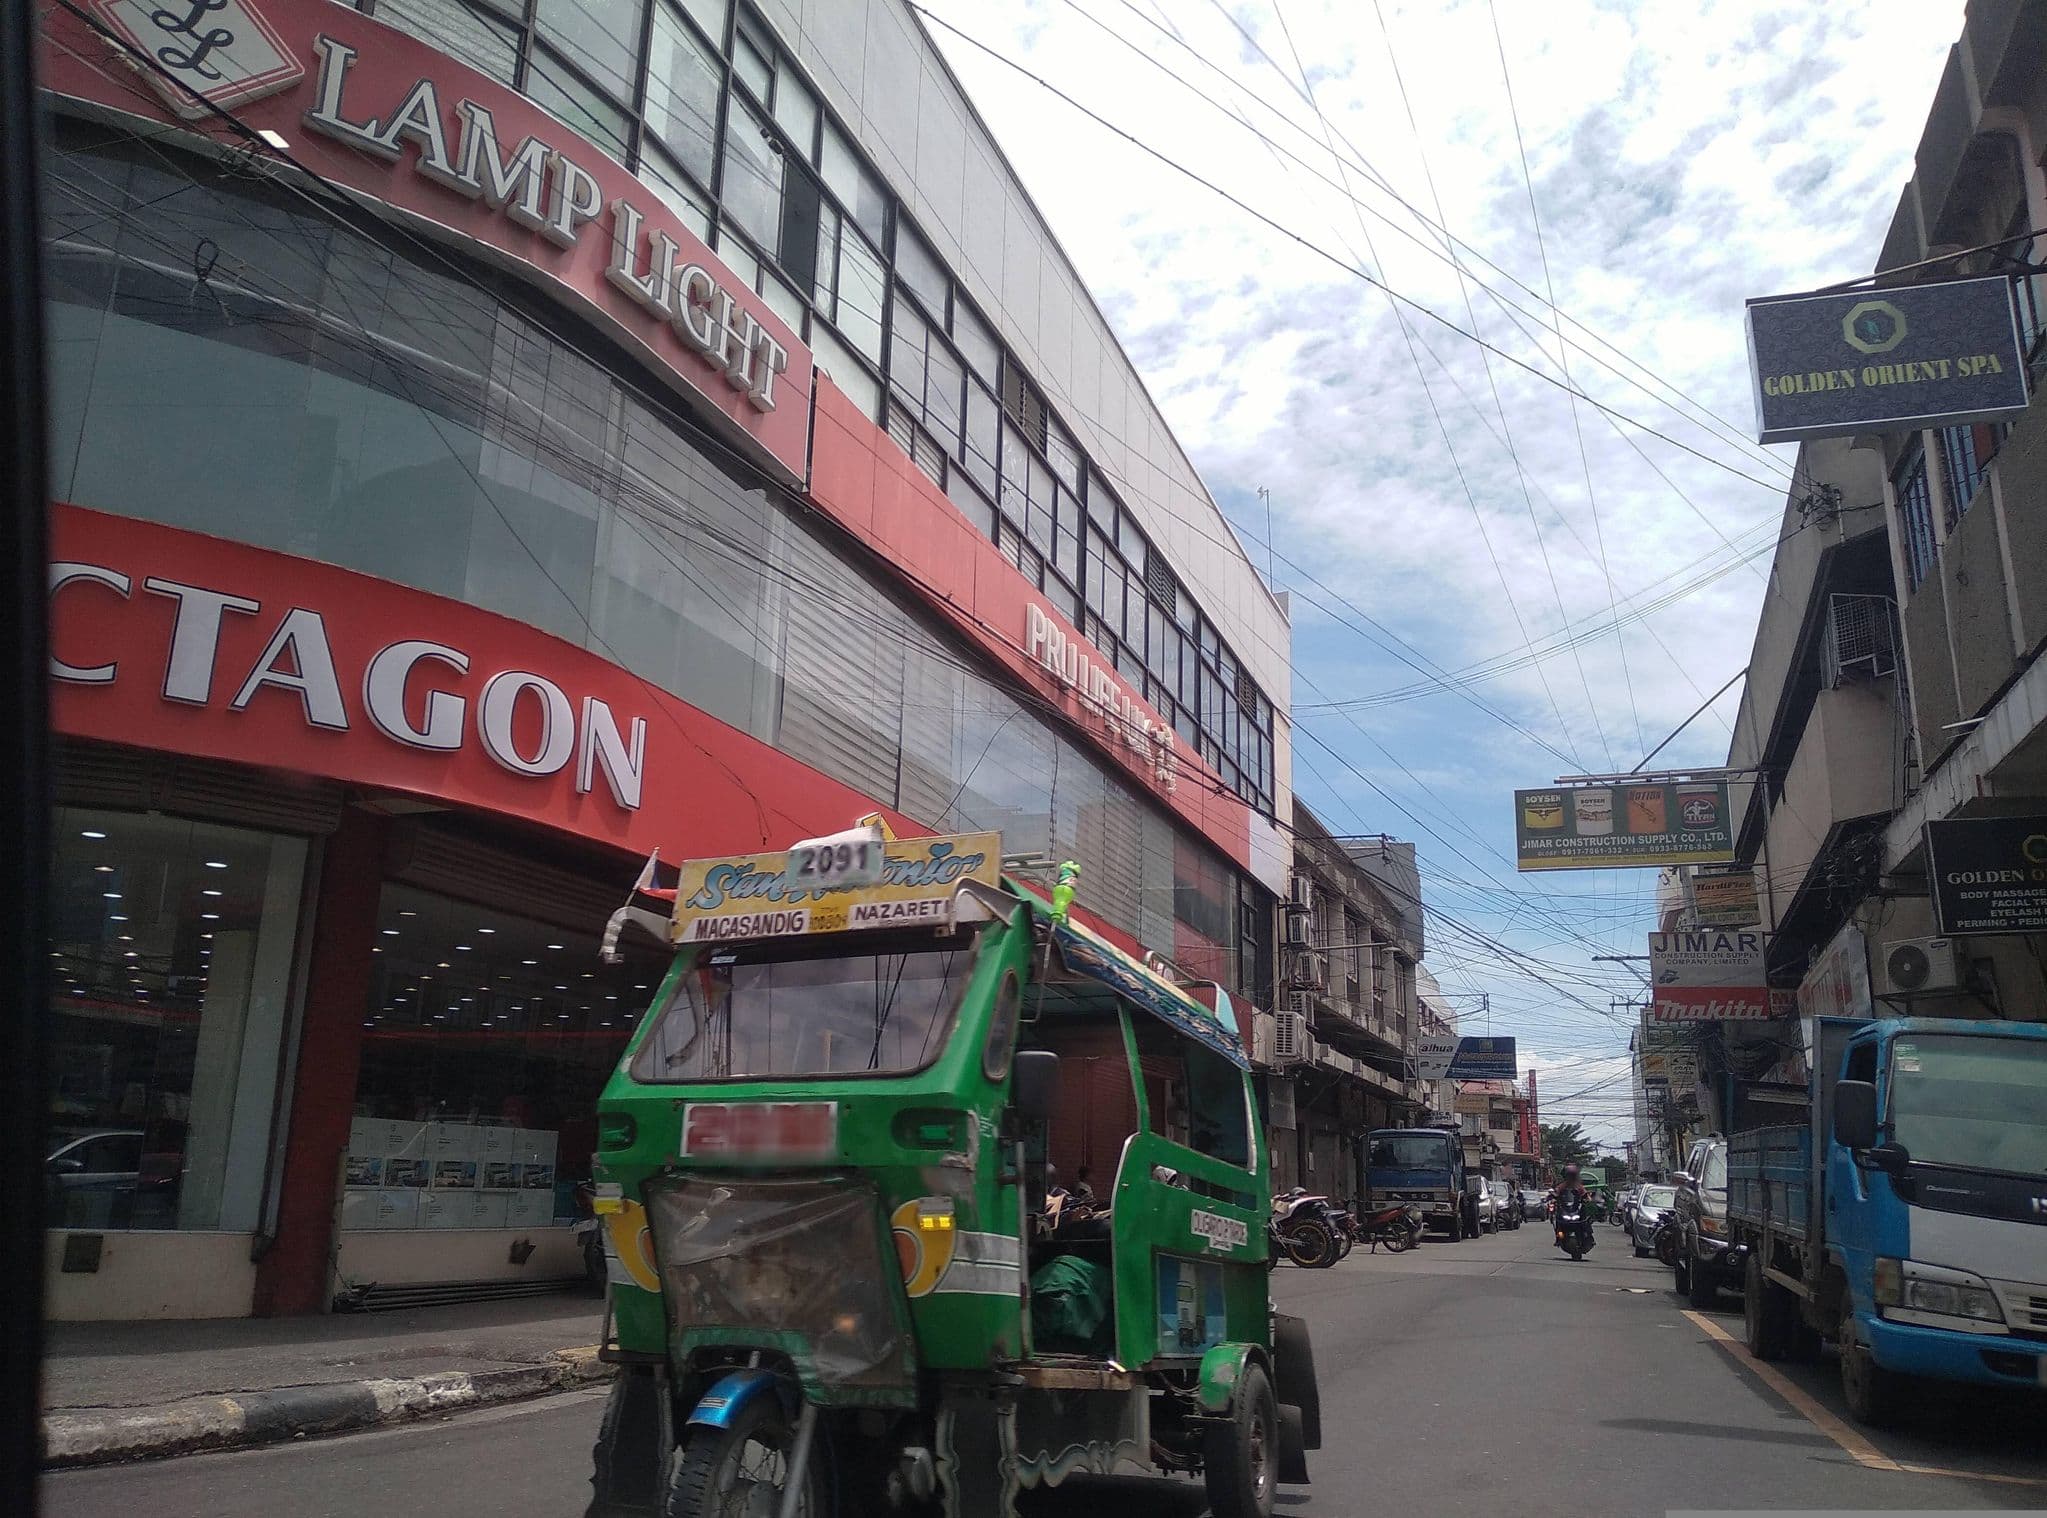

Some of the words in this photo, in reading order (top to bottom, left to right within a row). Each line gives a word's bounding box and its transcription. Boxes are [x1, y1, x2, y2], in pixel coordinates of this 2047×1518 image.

[301, 32, 604, 251] LAMP
[605, 196, 790, 413] LIGHT
[1763, 368, 1857, 397] GOLDEN
[1861, 358, 1951, 388] ORIENT
[1956, 352, 2003, 379] SPA
[1525, 793, 1562, 804] BOYSEN
[1521, 838, 1553, 849] JIMAR
[1555, 836, 1636, 848] CONSTRUCTION
[1637, 833, 1678, 845] SUPPLY
[1704, 830, 1728, 842] LTD.
[800, 843, 870, 876] 2091
[1946, 869, 2025, 885] GOLDEN
[1960, 891, 1990, 899] BODY
[1993, 888, 2047, 898] MASSAGE
[1991, 898, 2031, 907] FACIAL
[1990, 908, 2041, 917] EYELASH
[695, 910, 804, 940] MACASANDIG
[1957, 918, 2008, 928] PERMING
[1654, 932, 1760, 952] JIMAR
[1714, 957, 1750, 965] LIMITED
[1726, 951, 1760, 959] SUPPLY
